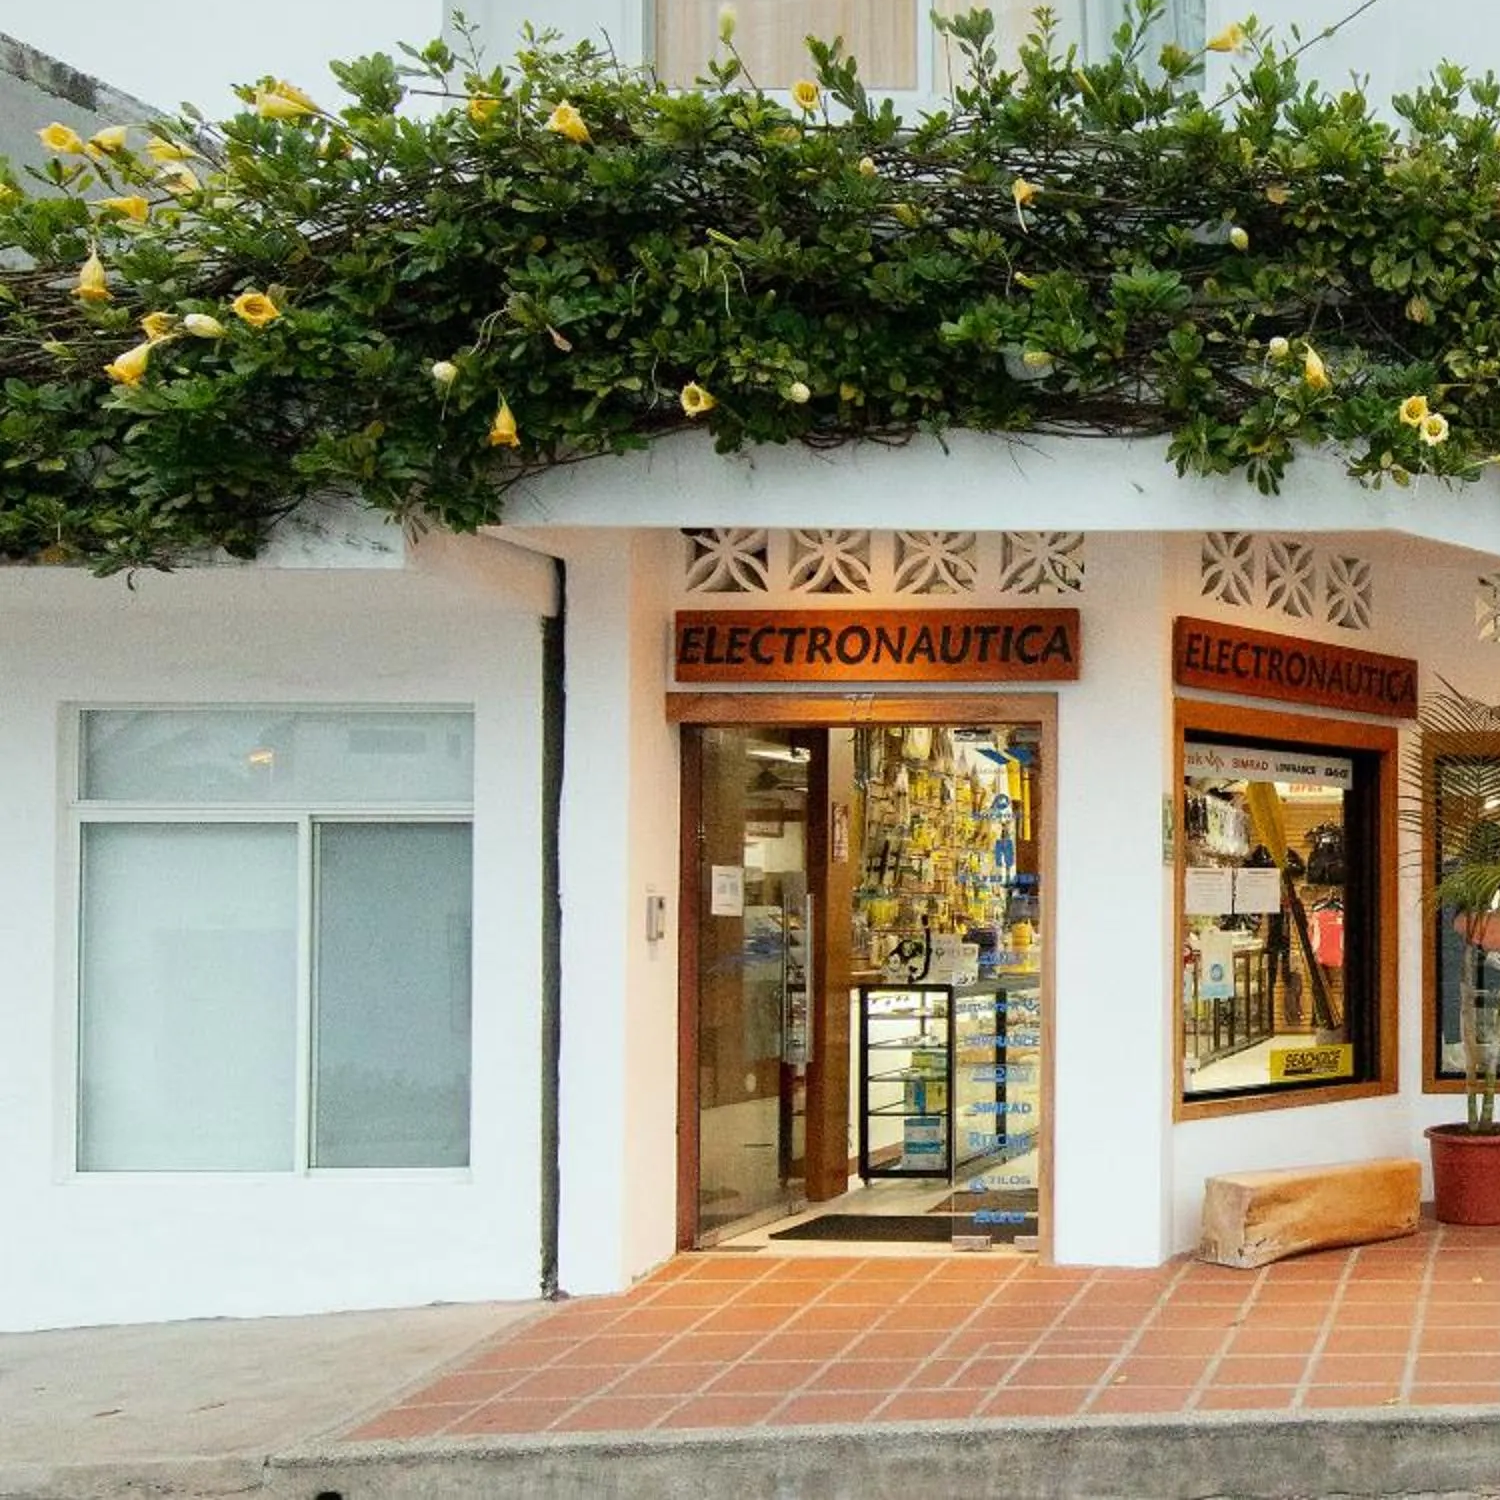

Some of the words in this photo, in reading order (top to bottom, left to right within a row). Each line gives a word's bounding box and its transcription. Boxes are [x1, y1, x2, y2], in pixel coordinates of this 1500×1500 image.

[678, 623, 1073, 666] ELECTRONAUTICA
[1184, 631, 1418, 705] ELECTRONAUTICA
[972, 1101, 1032, 1114] SIMRAD
